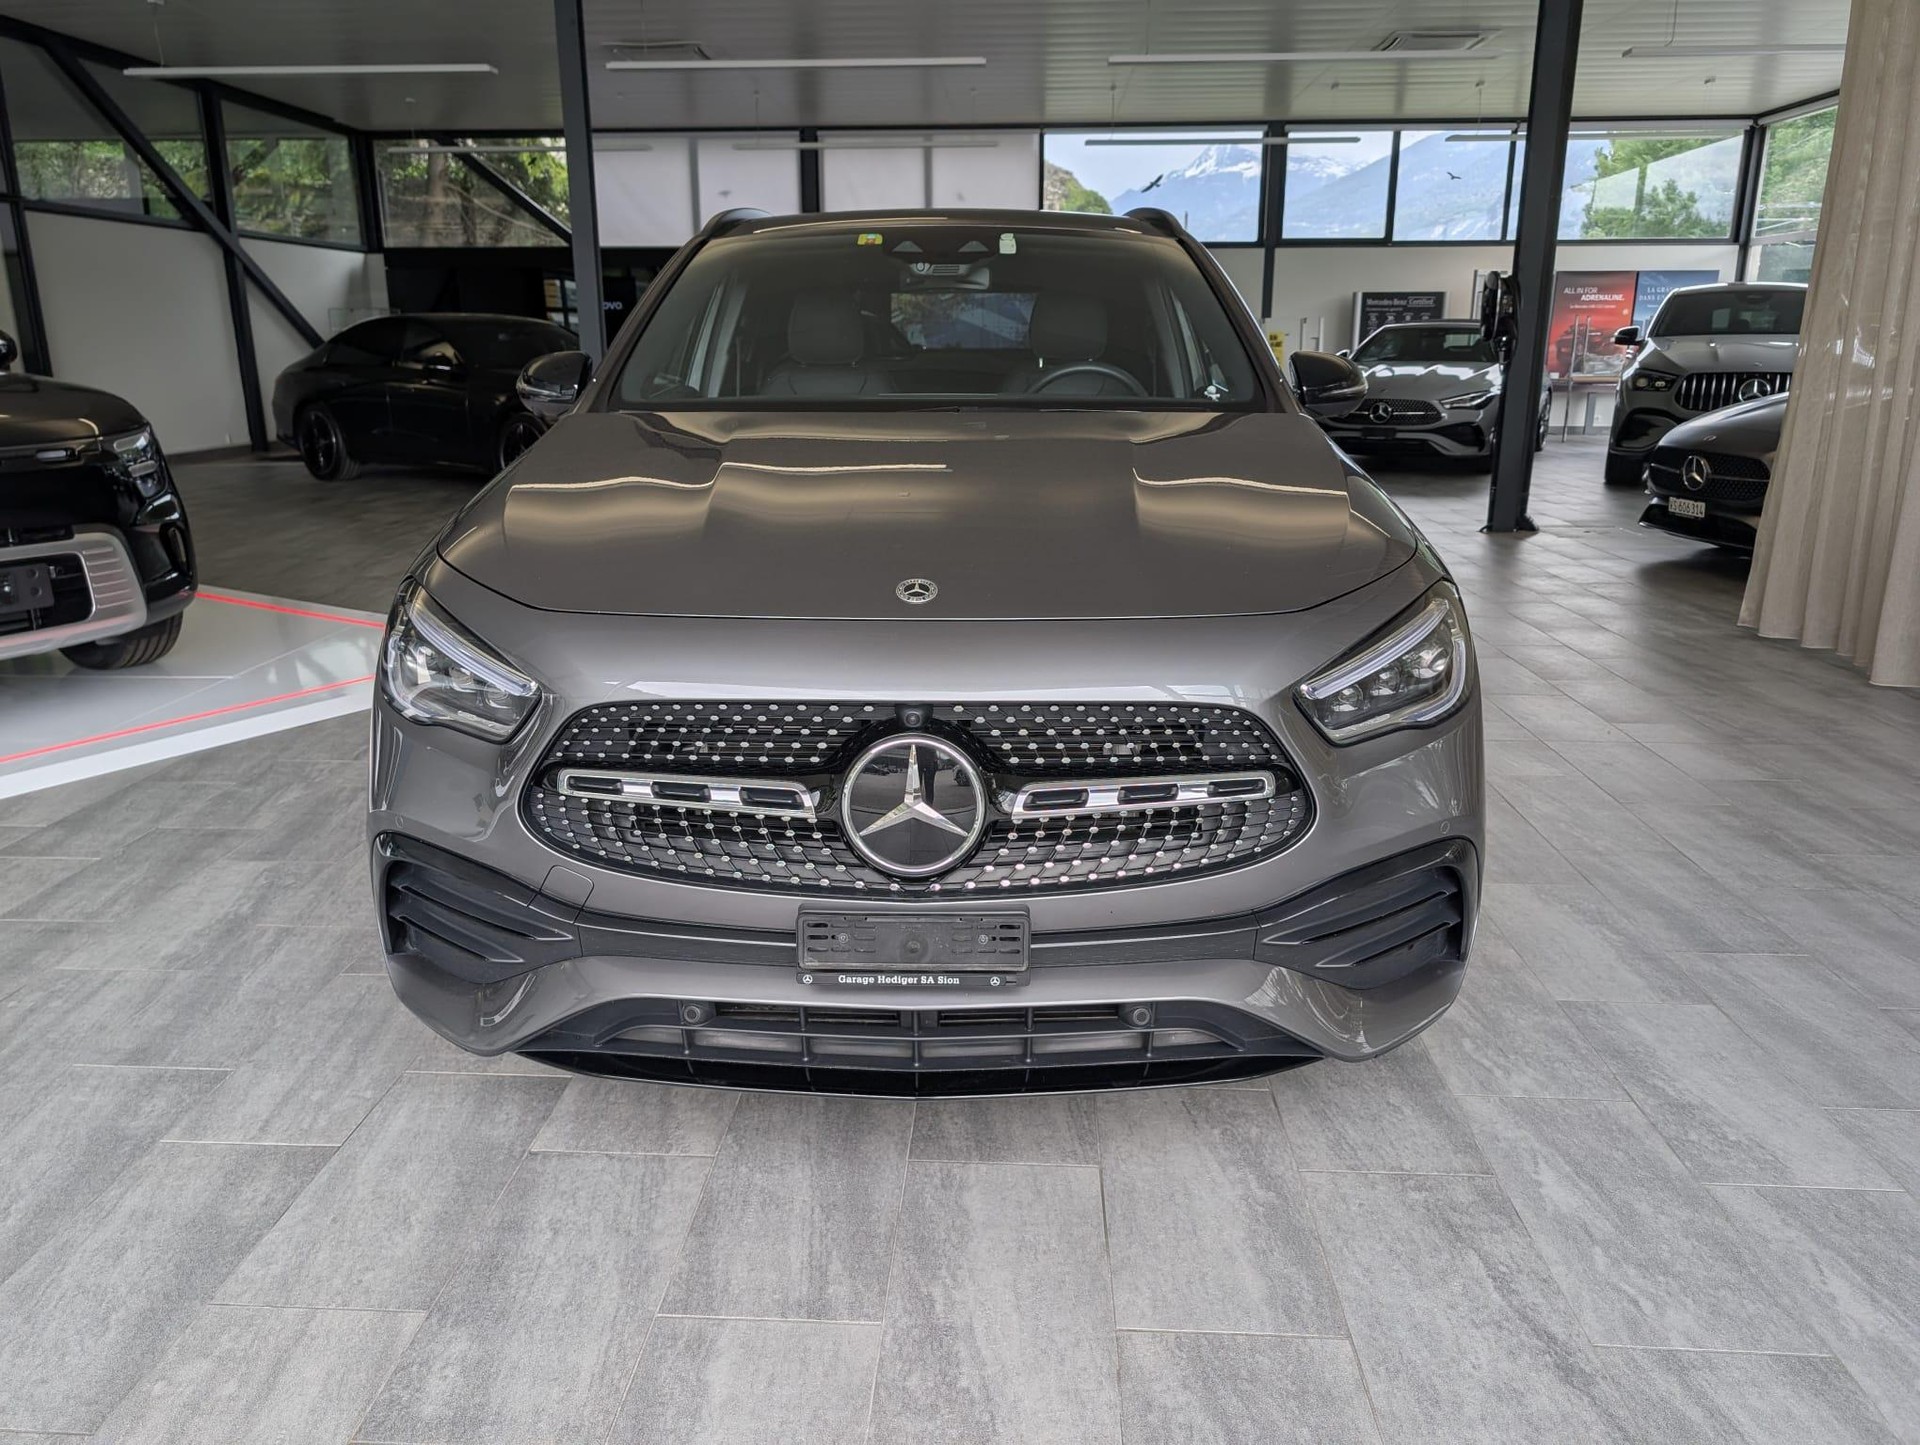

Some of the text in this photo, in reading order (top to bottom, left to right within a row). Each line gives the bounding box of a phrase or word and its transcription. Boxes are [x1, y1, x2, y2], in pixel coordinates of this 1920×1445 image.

[838, 975, 960, 985] Garage Hediger SA Sion
